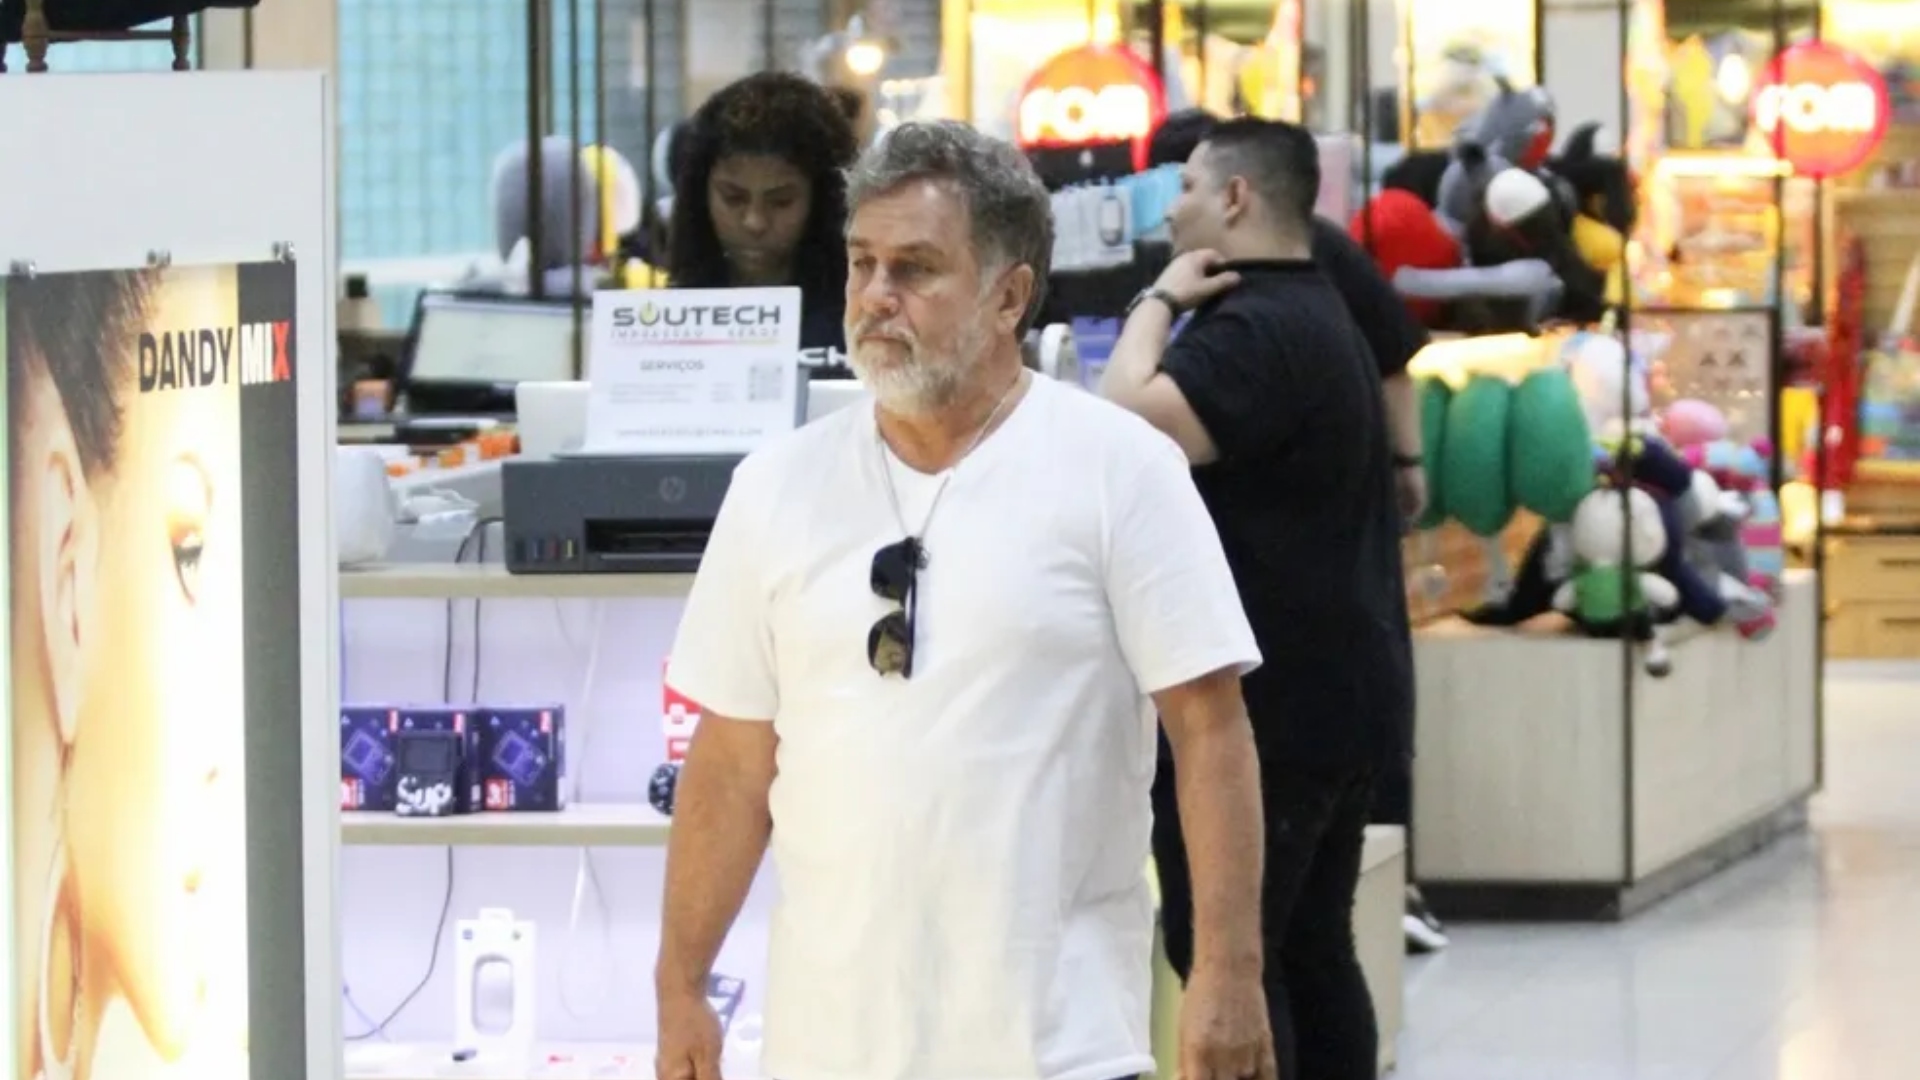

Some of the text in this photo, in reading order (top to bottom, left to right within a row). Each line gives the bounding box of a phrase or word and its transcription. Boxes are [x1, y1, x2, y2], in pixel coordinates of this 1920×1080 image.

[612, 301, 781, 327] SOUTECH
[138, 319, 291, 393] DANDY MIX
